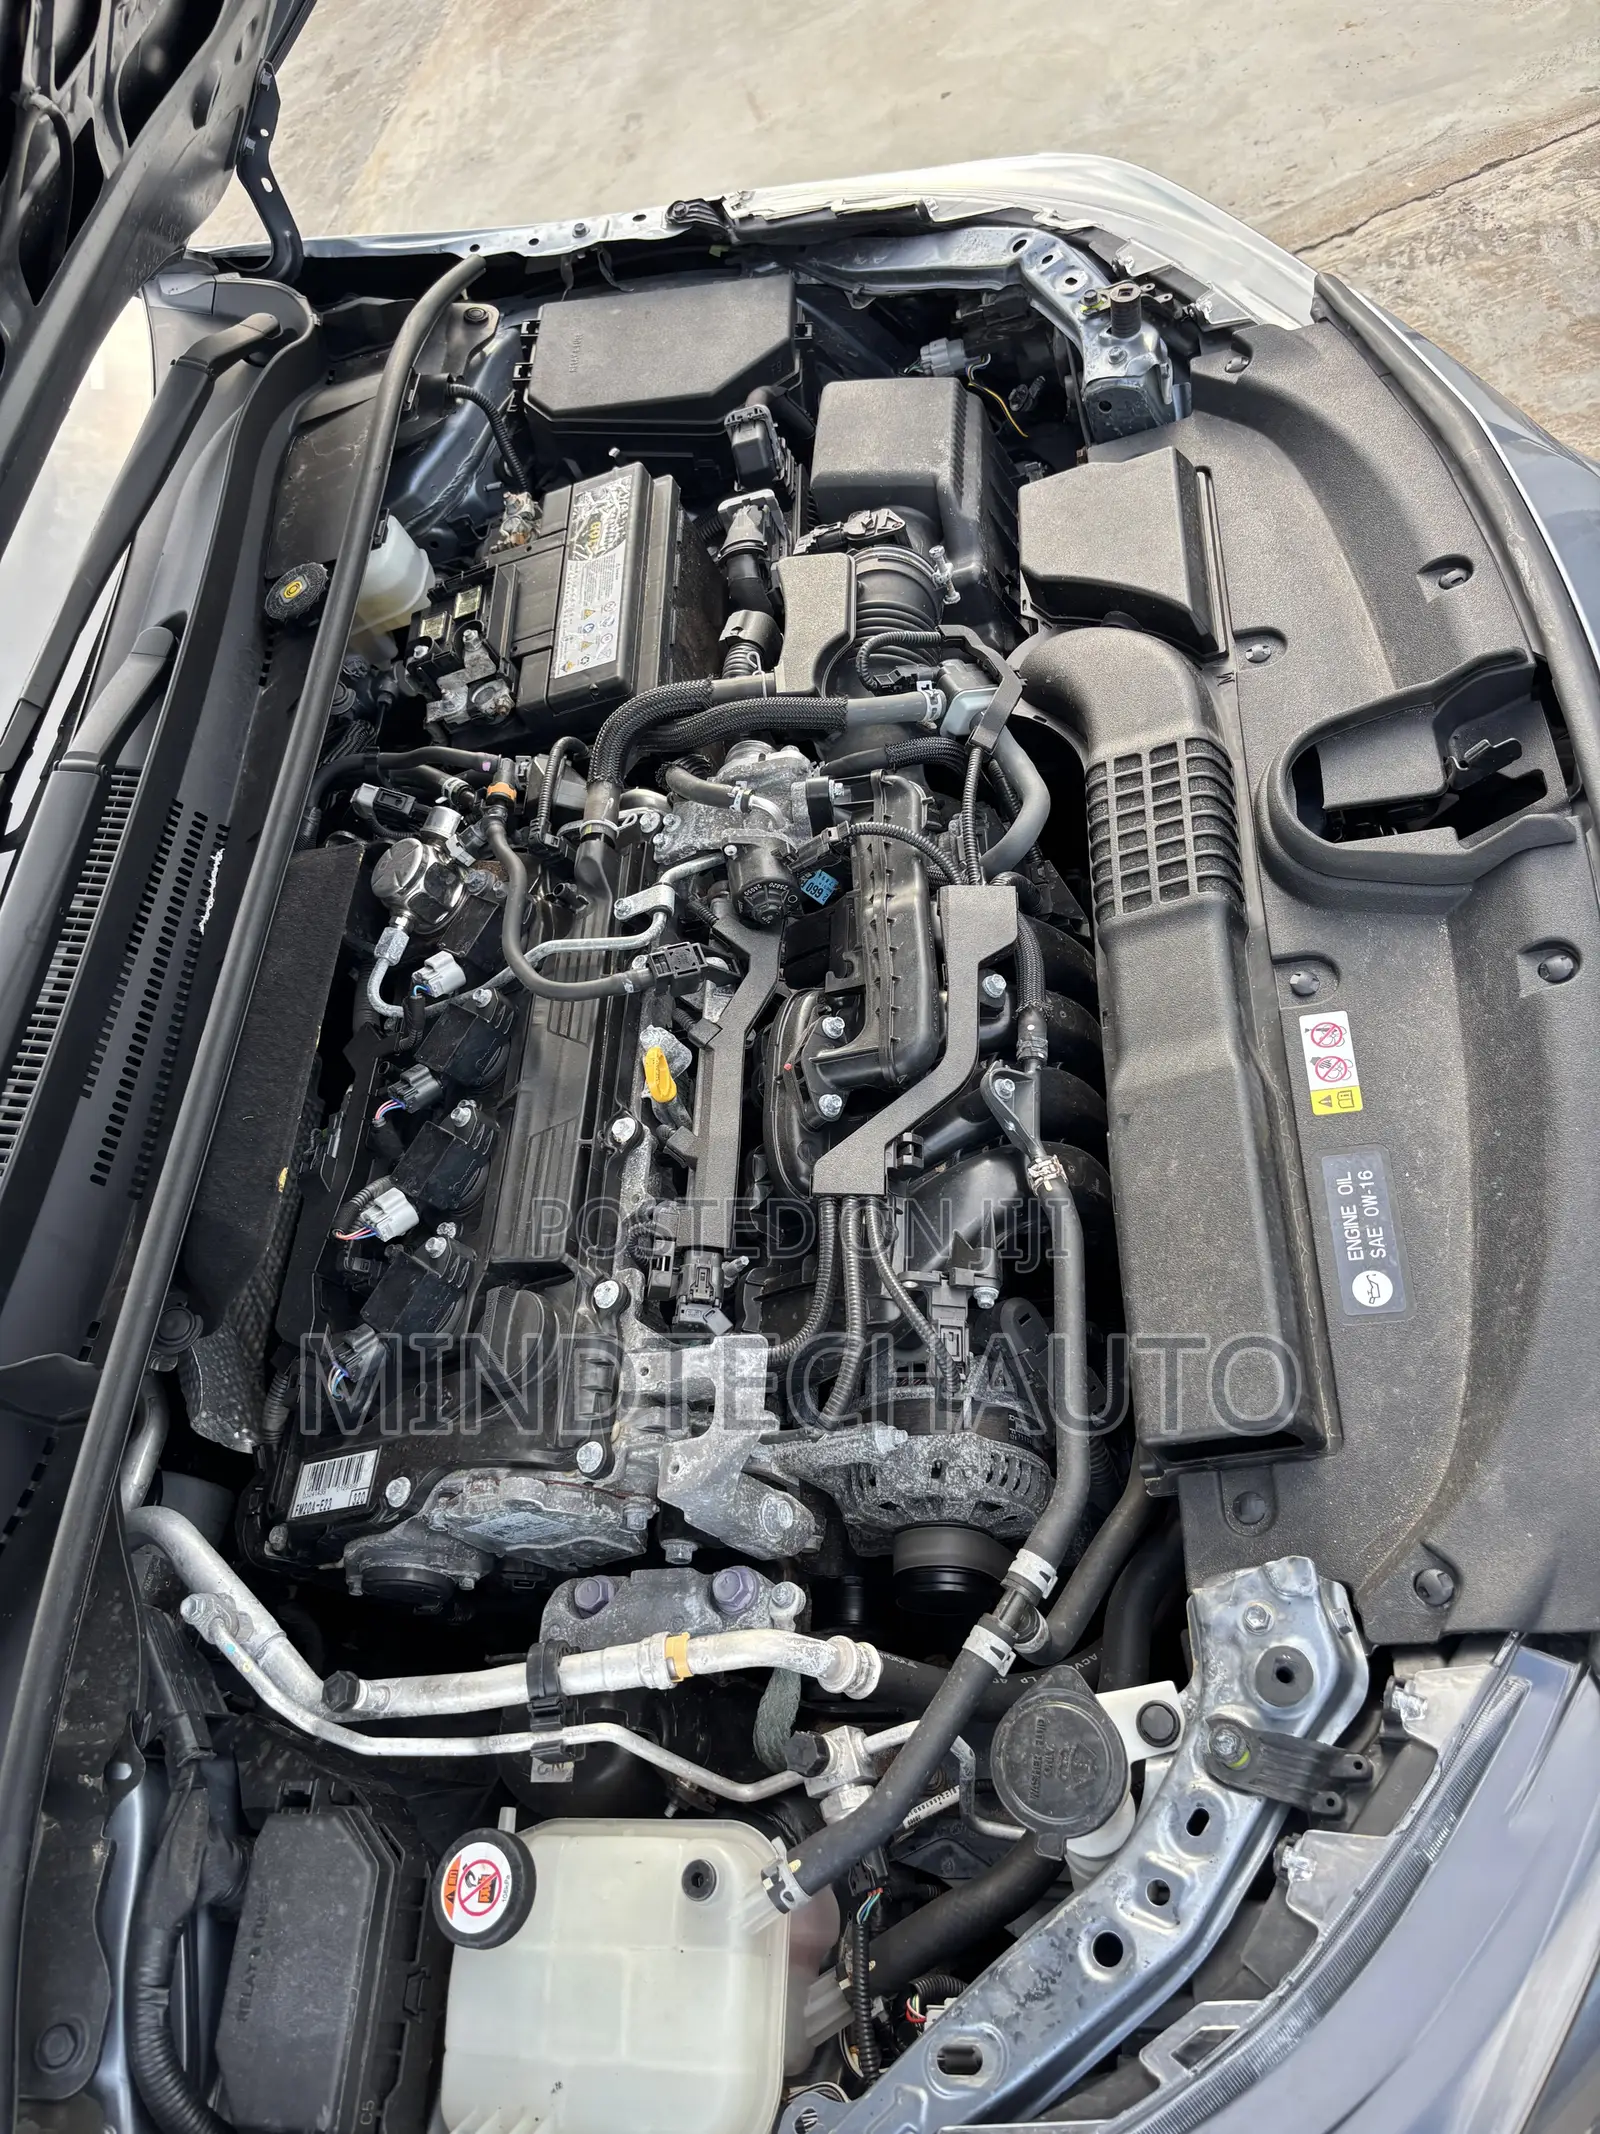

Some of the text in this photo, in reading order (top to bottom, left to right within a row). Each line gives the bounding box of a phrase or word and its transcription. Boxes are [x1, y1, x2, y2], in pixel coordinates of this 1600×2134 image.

[1336, 1171, 1365, 1261] ENGINE OIL
[1367, 1226, 1387, 1258] SAE
[1028, 1753, 1043, 1800] WASHER
[359, 2100, 375, 2125] C5
